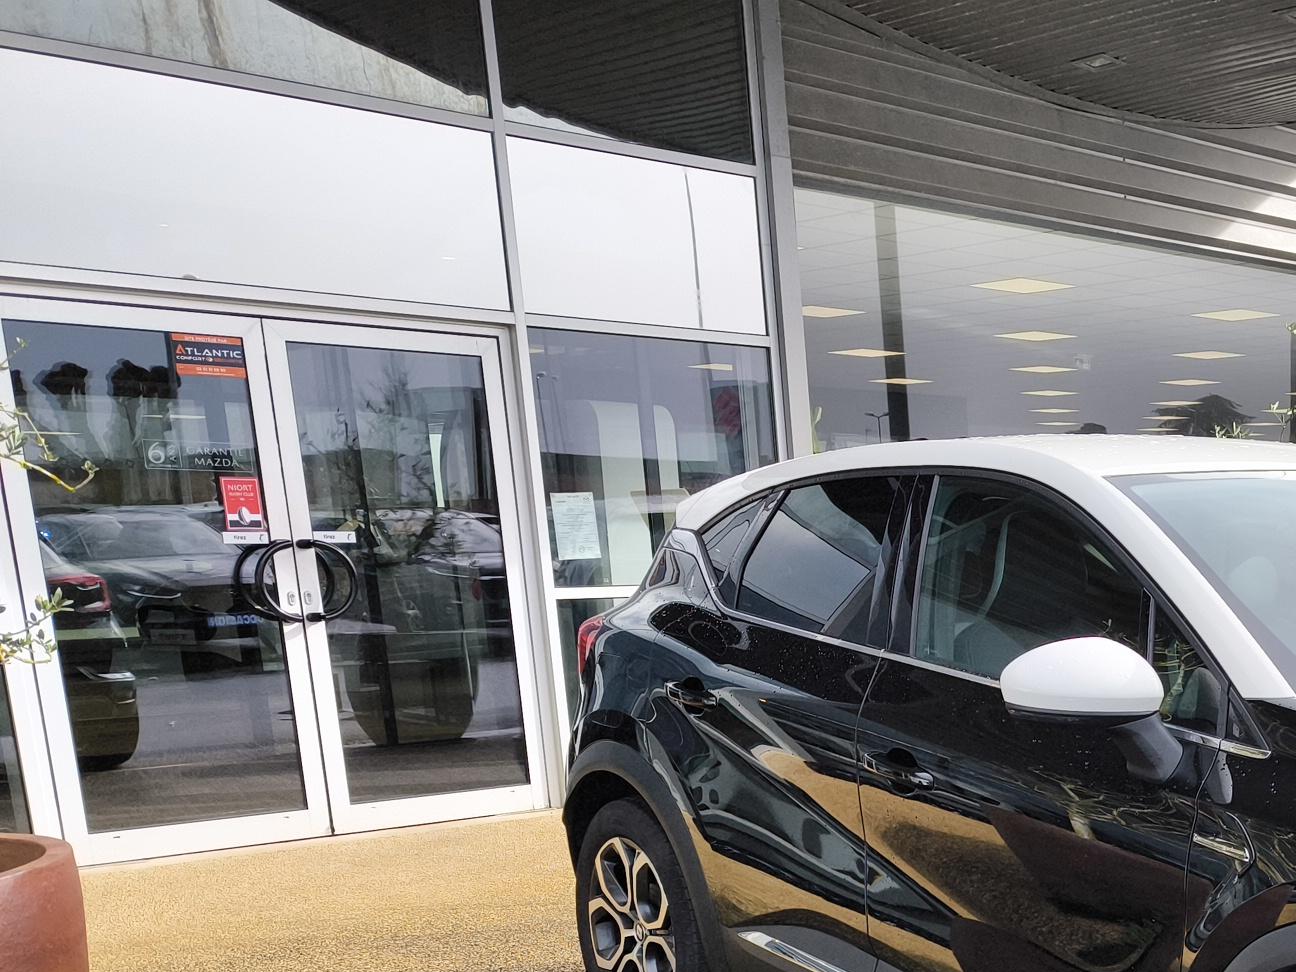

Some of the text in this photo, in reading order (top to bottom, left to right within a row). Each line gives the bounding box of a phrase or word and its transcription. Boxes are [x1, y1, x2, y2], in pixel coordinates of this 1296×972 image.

[176, 343, 242, 358] ATLANTIC
[148, 442, 165, 463] 6
[194, 457, 240, 467] MAZDA
[228, 484, 253, 492] NIORT
